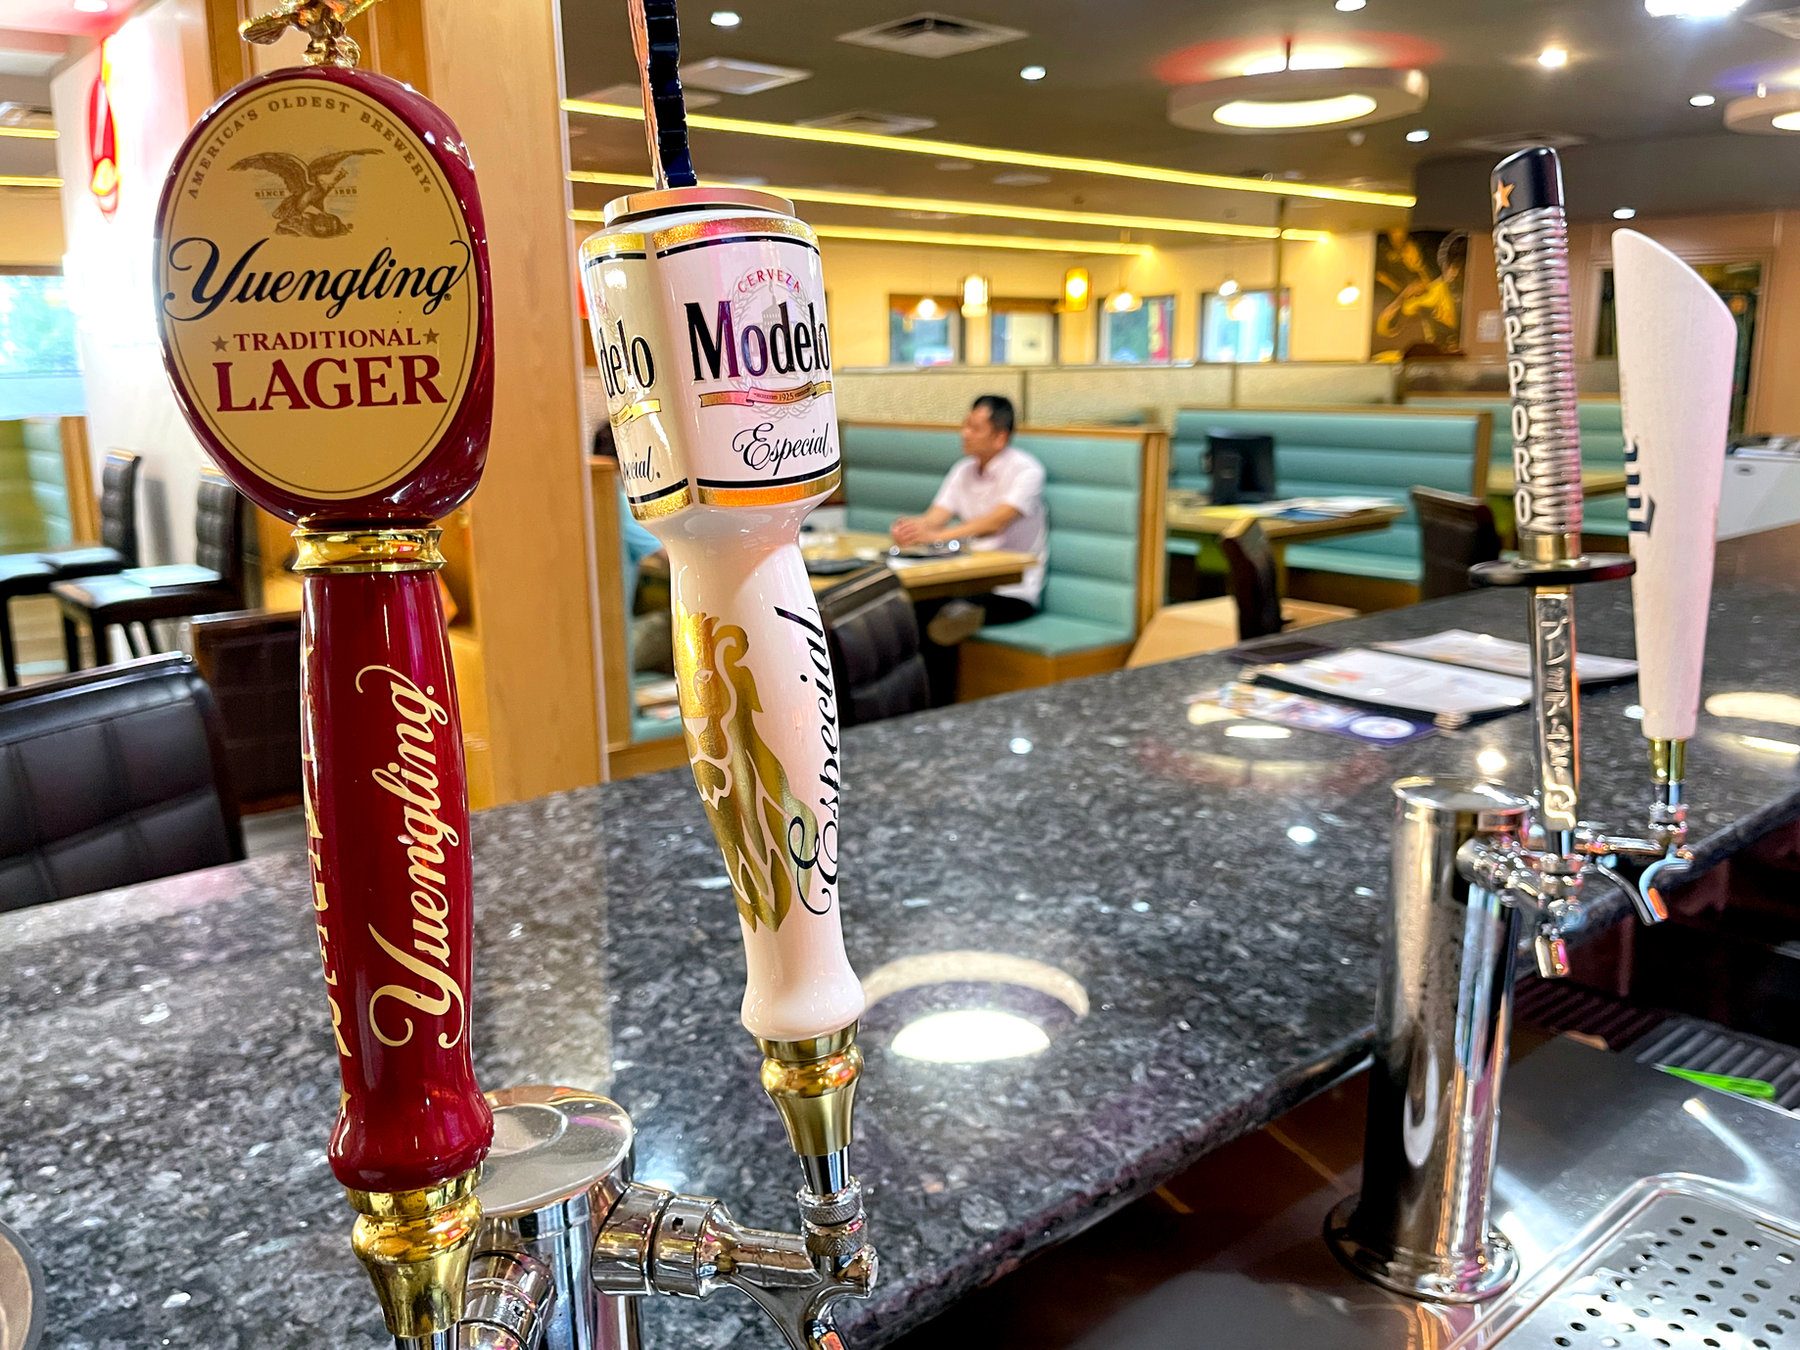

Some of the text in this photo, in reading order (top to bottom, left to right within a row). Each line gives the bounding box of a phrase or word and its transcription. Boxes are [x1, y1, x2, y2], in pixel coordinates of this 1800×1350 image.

[188, 95, 432, 200] AMERICA'S OLDEST BREWERY
[254, 190, 286, 198] SINCE
[162, 236, 472, 321] Yuengling
[737, 268, 801, 294] CERVEZA
[233, 328, 421, 352] TRADITIONAL
[599, 319, 656, 399] delo
[684, 300, 830, 383] Modelo
[1498, 227, 1533, 527] SAPPORO
[212, 354, 448, 413] LAGER
[779, 391, 795, 402] 1925
[355, 664, 466, 1050] Yuengling
